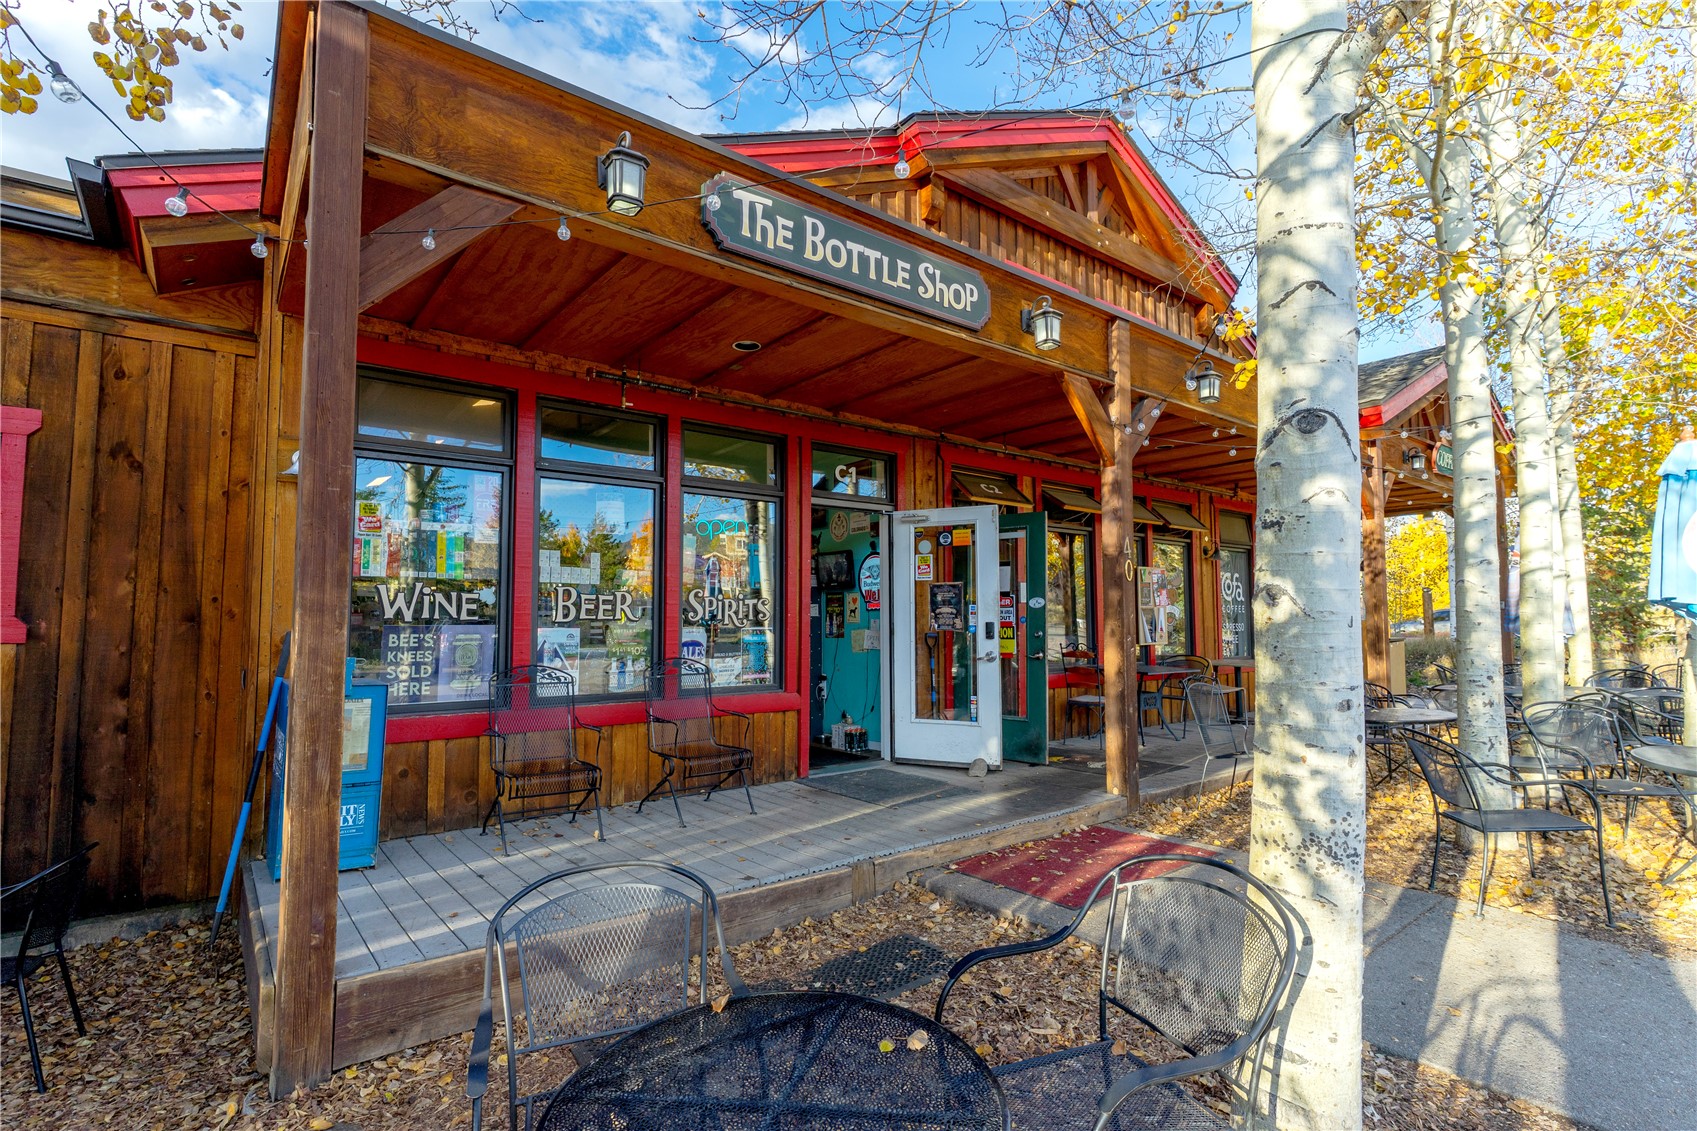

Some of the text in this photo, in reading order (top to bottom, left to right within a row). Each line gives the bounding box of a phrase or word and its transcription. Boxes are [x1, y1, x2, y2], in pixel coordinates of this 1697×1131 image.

[803, 215, 911, 290] BOTTLE
[835, 465, 856, 483] C1
[980, 483, 1003, 494] C2
[696, 518, 749, 540] open
[863, 580, 880, 588] Budwe
[864, 589, 877, 602] We
[555, 586, 640, 623] BEER
[1222, 605, 1245, 613] COFFEE
[1000, 627, 1013, 639] ION
[1222, 622, 1245, 632] SPRESSO
[388, 633, 434, 647] BEE'S
[387, 651, 433, 663] KNEES
[682, 645, 706, 659] ALE'S
[387, 665, 432, 679] SOLD
[388, 681, 431, 696] HERE
[341, 804, 357, 816] IT
[340, 815, 356, 827] LY
